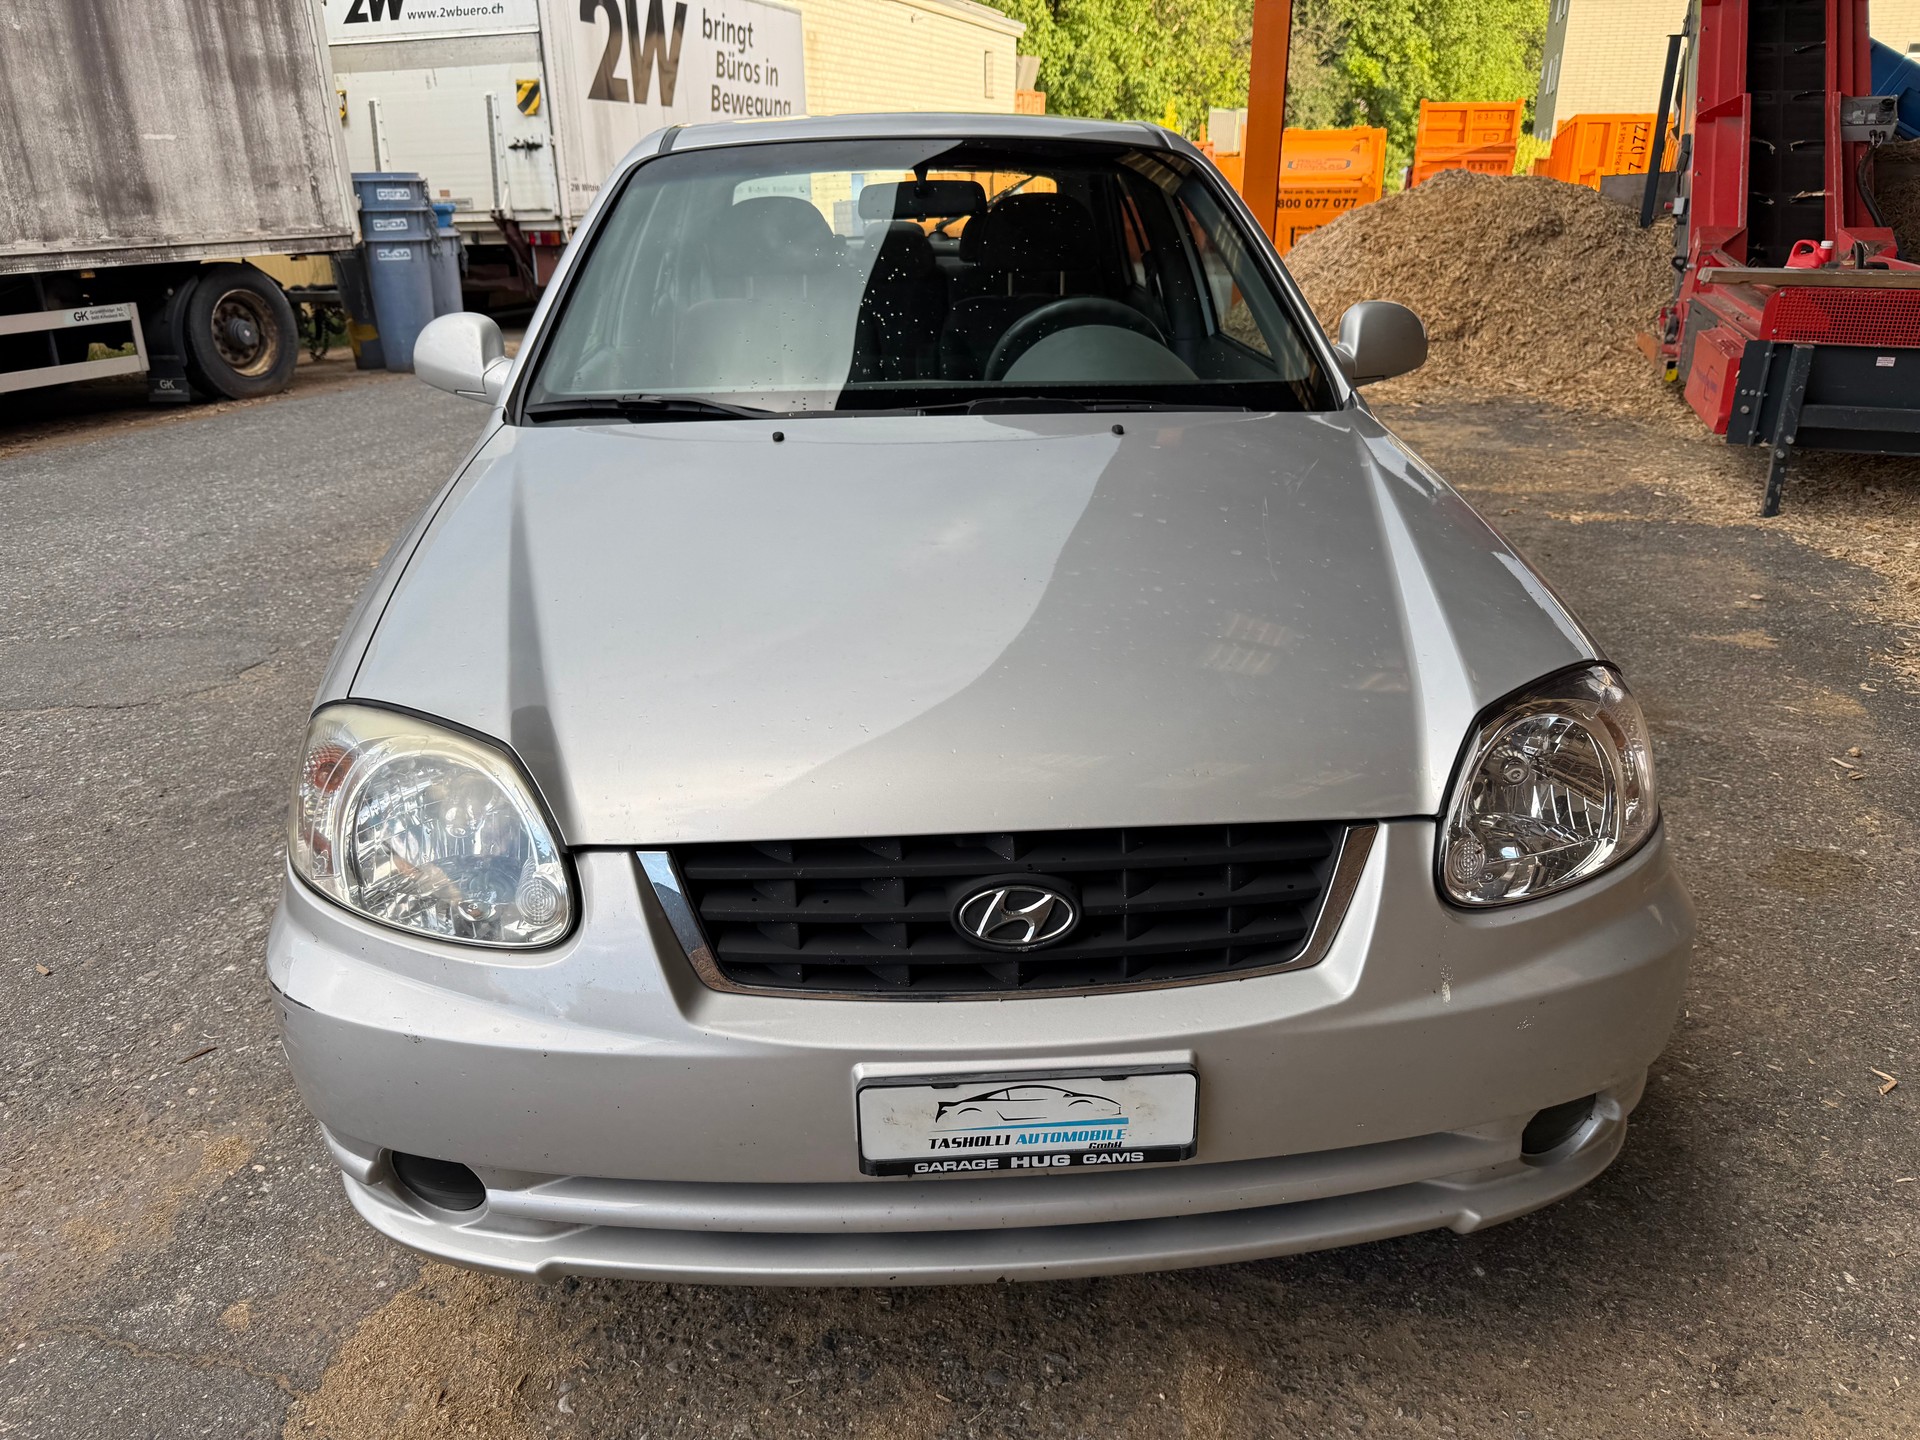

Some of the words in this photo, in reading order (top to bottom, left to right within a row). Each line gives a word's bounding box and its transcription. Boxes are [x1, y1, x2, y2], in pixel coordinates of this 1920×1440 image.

[407, 3, 504, 20] www.2wbuero.ch
[702, 8, 753, 54] bringt
[580, 0, 688, 107] 2W
[716, 51, 761, 84] Büros
[765, 58, 779, 87] in
[1305, 198, 1329, 208] 077
[1333, 198, 1357, 208] 077
[73, 310, 90, 322] GK
[160, 380, 175, 389] GK
[929, 1134, 1011, 1150] TASHOLLI
[1015, 1128, 1127, 1145] AUTOMOBILE
[1089, 1141, 1122, 1149] GmbH
[914, 1158, 999, 1173] GARAGE
[1010, 1154, 1071, 1169] HUG
[1083, 1152, 1145, 1164] GAMS
